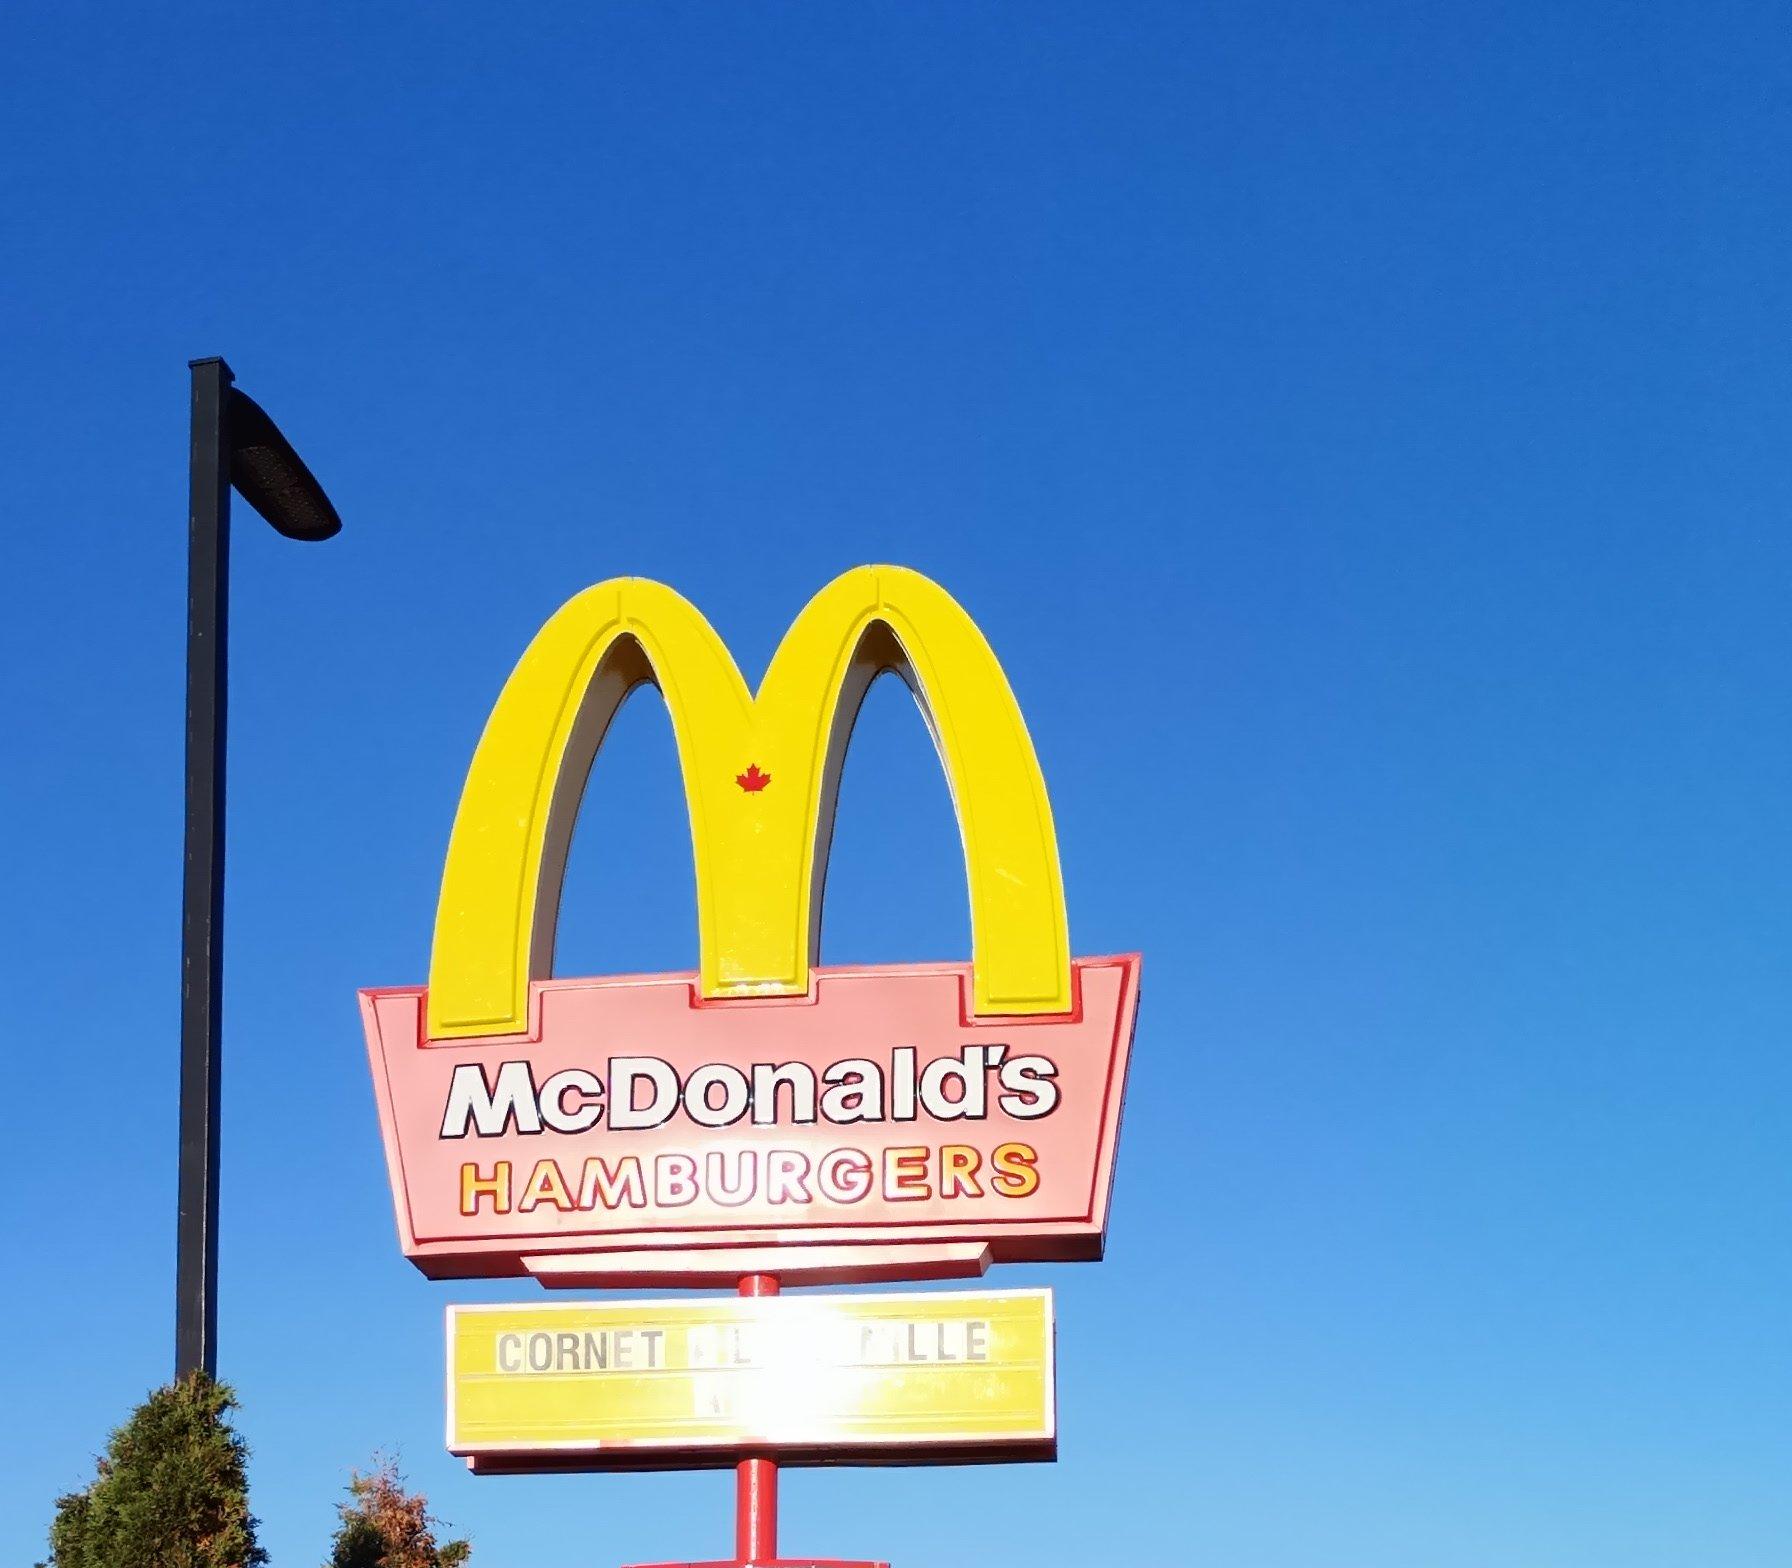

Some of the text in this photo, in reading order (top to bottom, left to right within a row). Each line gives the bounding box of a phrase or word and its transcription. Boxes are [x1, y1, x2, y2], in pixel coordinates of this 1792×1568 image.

[439, 1044, 1060, 1140] McDonald's
[460, 1142, 1040, 1217] HAMBURGERS
[498, 1330, 664, 1372] CORNET
